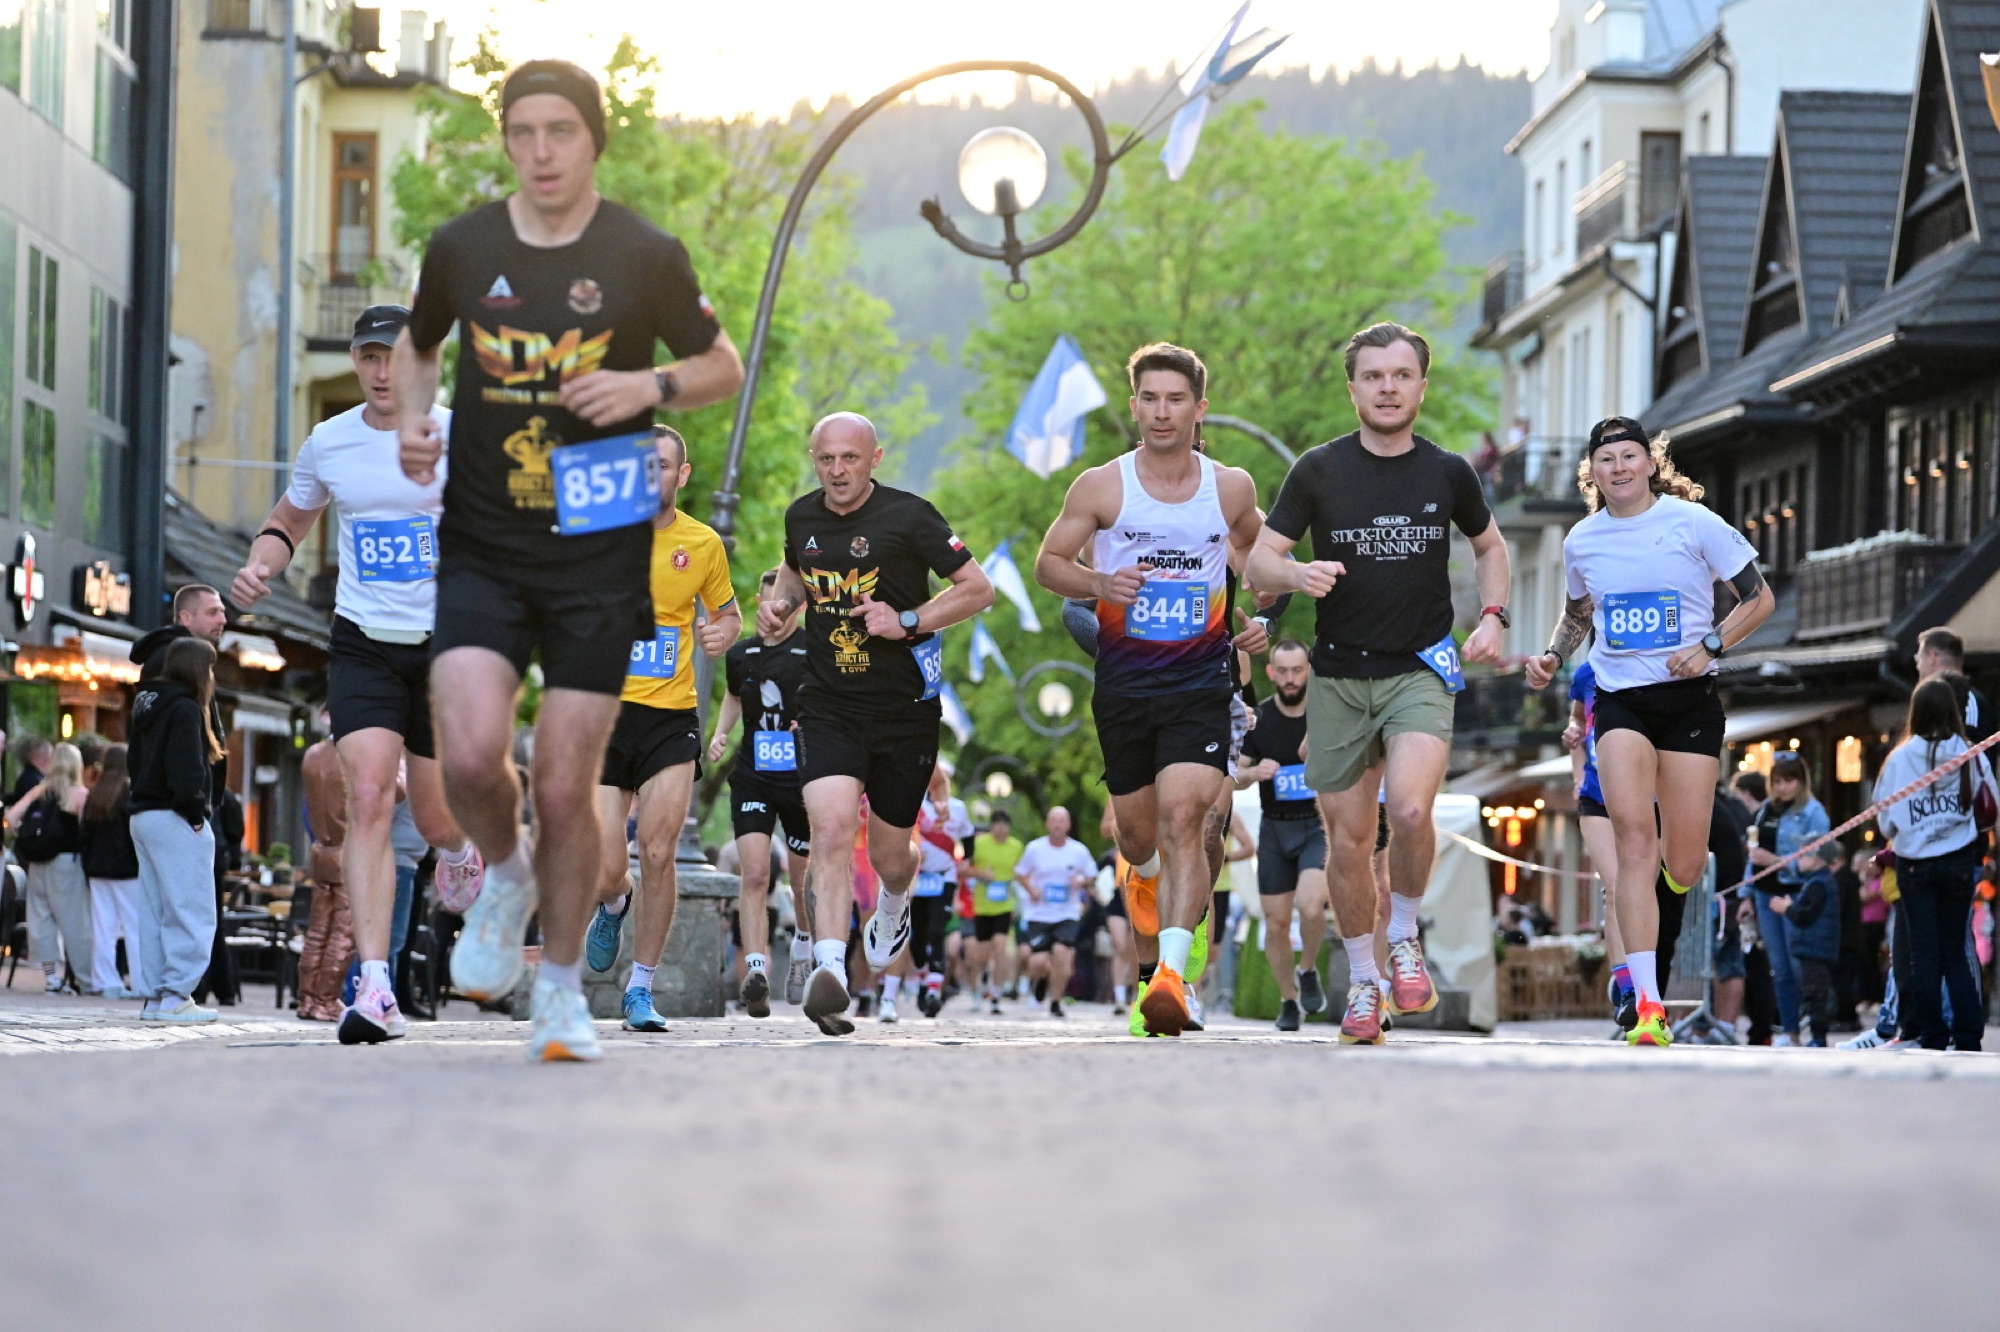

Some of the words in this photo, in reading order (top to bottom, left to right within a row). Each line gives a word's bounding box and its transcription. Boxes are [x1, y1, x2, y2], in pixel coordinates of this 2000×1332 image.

[563, 457, 640, 509] 857
[1377, 516, 1406, 525] GLUE
[1330, 525, 1445, 543] STICK-TOGETHER
[360, 535, 415, 565] 852
[1156, 549, 1186, 557] VALENCIA
[1356, 540, 1427, 556] RUNNING
[1131, 596, 1188, 624] 844
[1610, 606, 1661, 635] 889
[629, 640, 658, 663] 81
[1434, 645, 1461, 676] 92
[923, 647, 942, 683] 85
[758, 741, 796, 761] 865
[741, 801, 767, 813] UFC
[788, 835, 810, 851] UF
